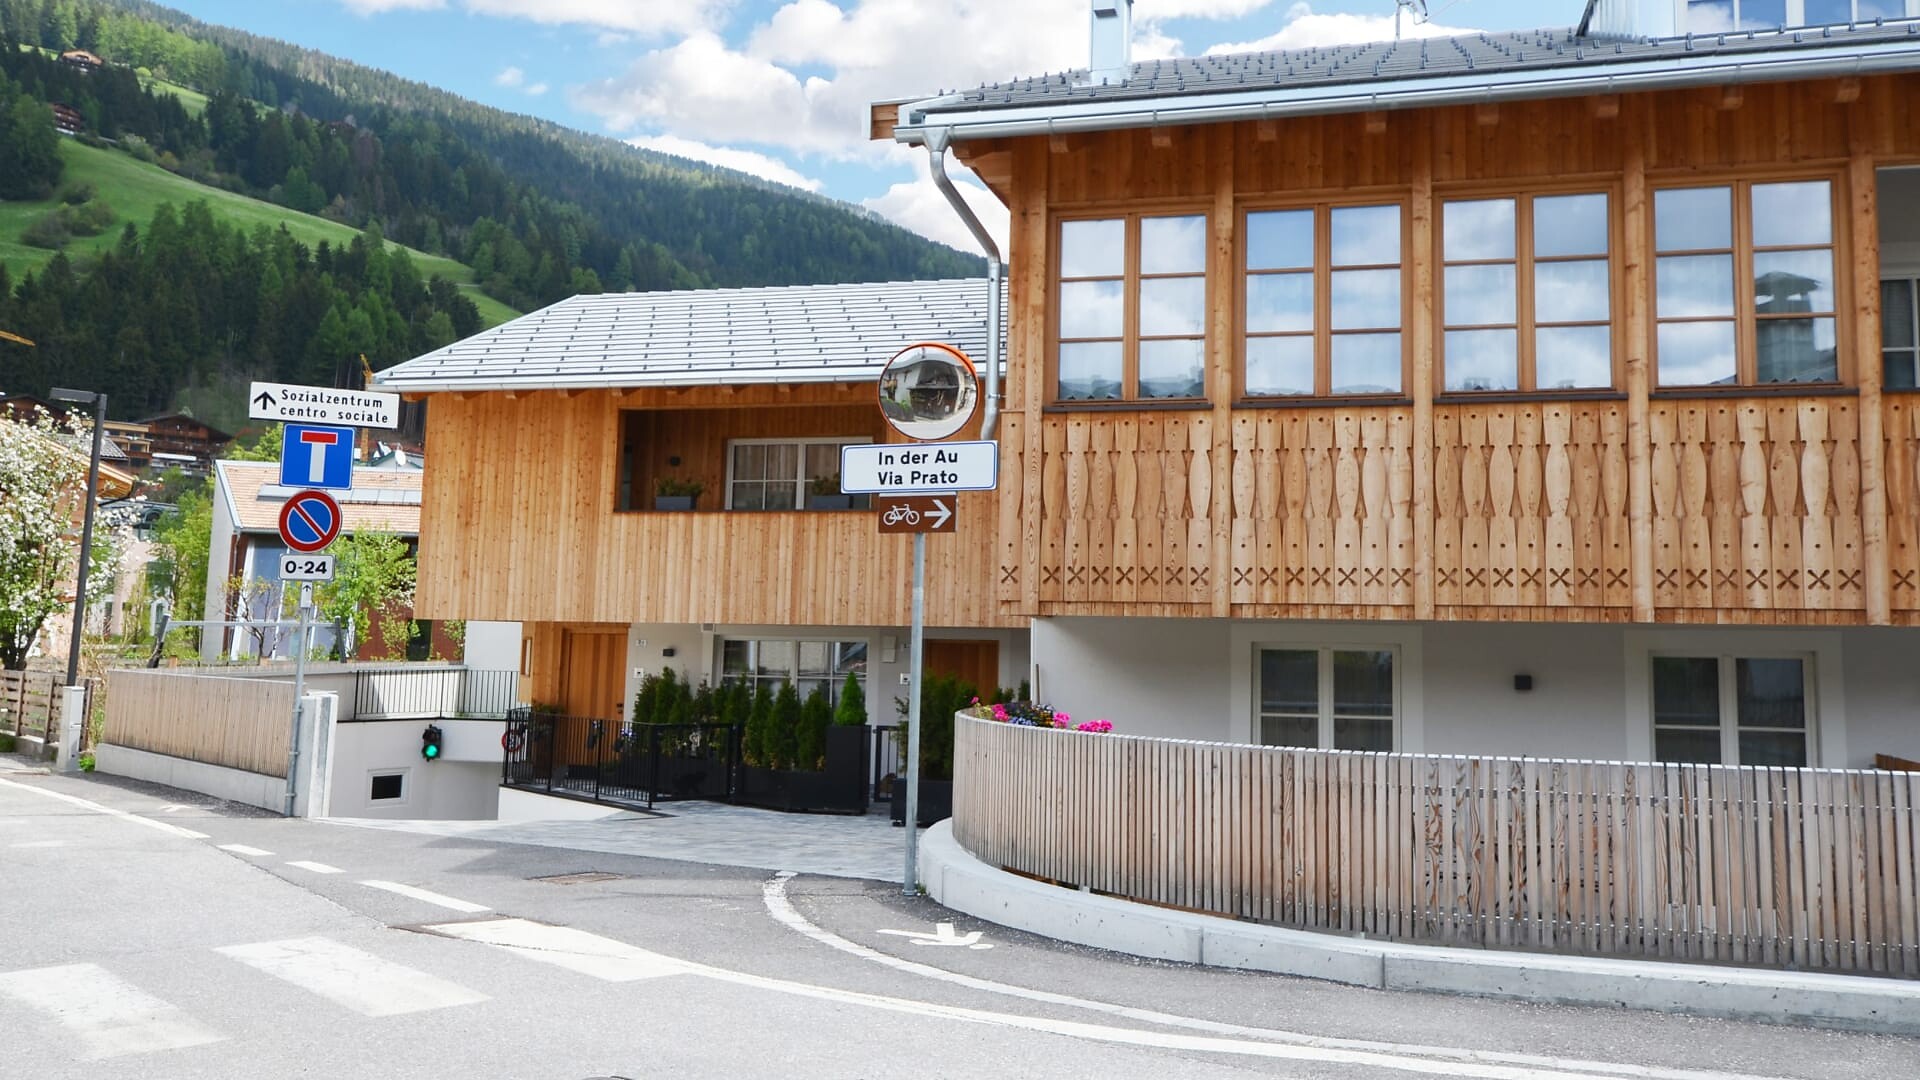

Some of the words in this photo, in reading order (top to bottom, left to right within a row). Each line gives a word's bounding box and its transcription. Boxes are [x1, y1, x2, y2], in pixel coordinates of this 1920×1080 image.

[281, 389, 383, 408] Sozialzentrum
[280, 405, 327, 418] centro
[338, 408, 388, 424] sociale
[878, 451, 894, 465] In
[900, 450, 928, 465] der
[934, 449, 958, 464] Au
[878, 471, 903, 485] Via
[911, 470, 958, 485] Prato
[284, 560, 327, 575] 0-24
